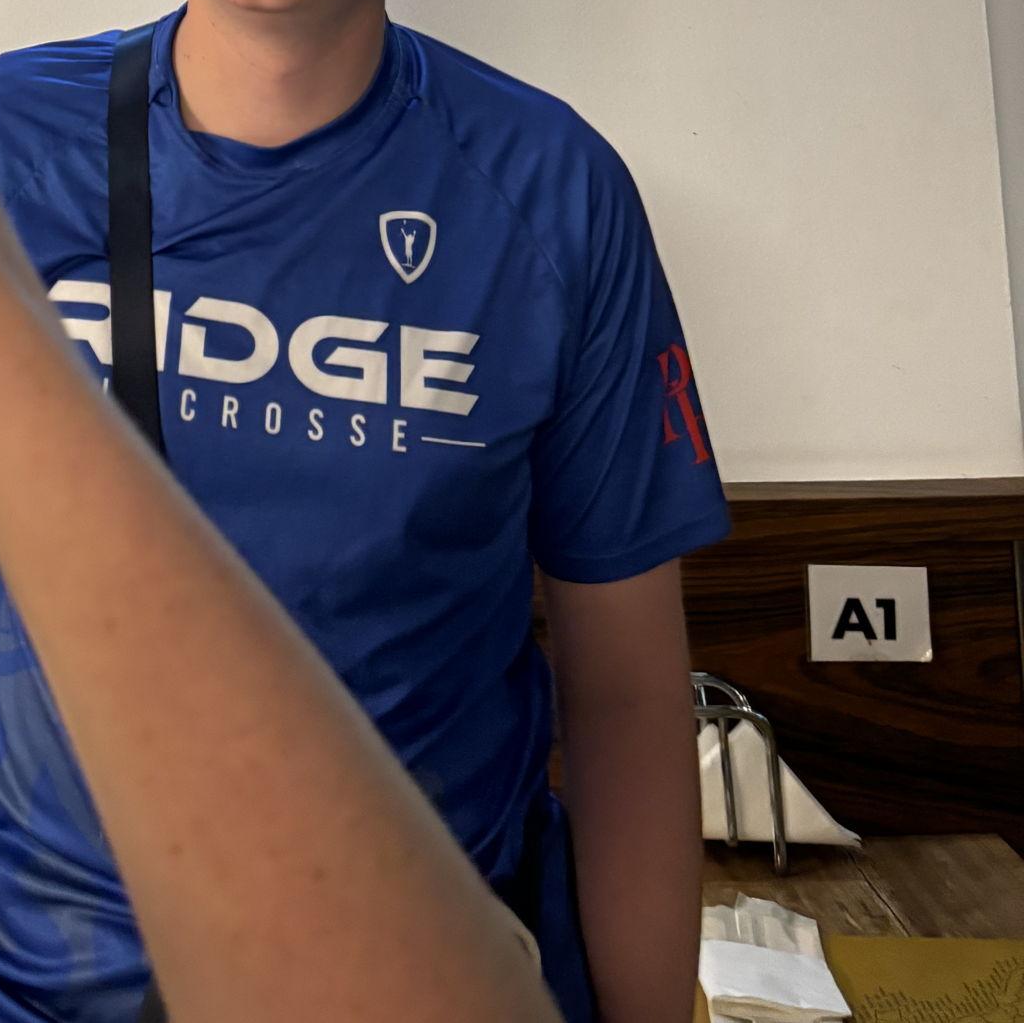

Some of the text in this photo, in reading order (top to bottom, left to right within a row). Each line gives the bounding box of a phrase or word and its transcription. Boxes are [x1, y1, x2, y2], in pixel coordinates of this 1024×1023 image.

[47, 279, 481, 417] RIDGE
[102, 378, 408, 453] CROSSE
[832, 597, 897, 641] A1
